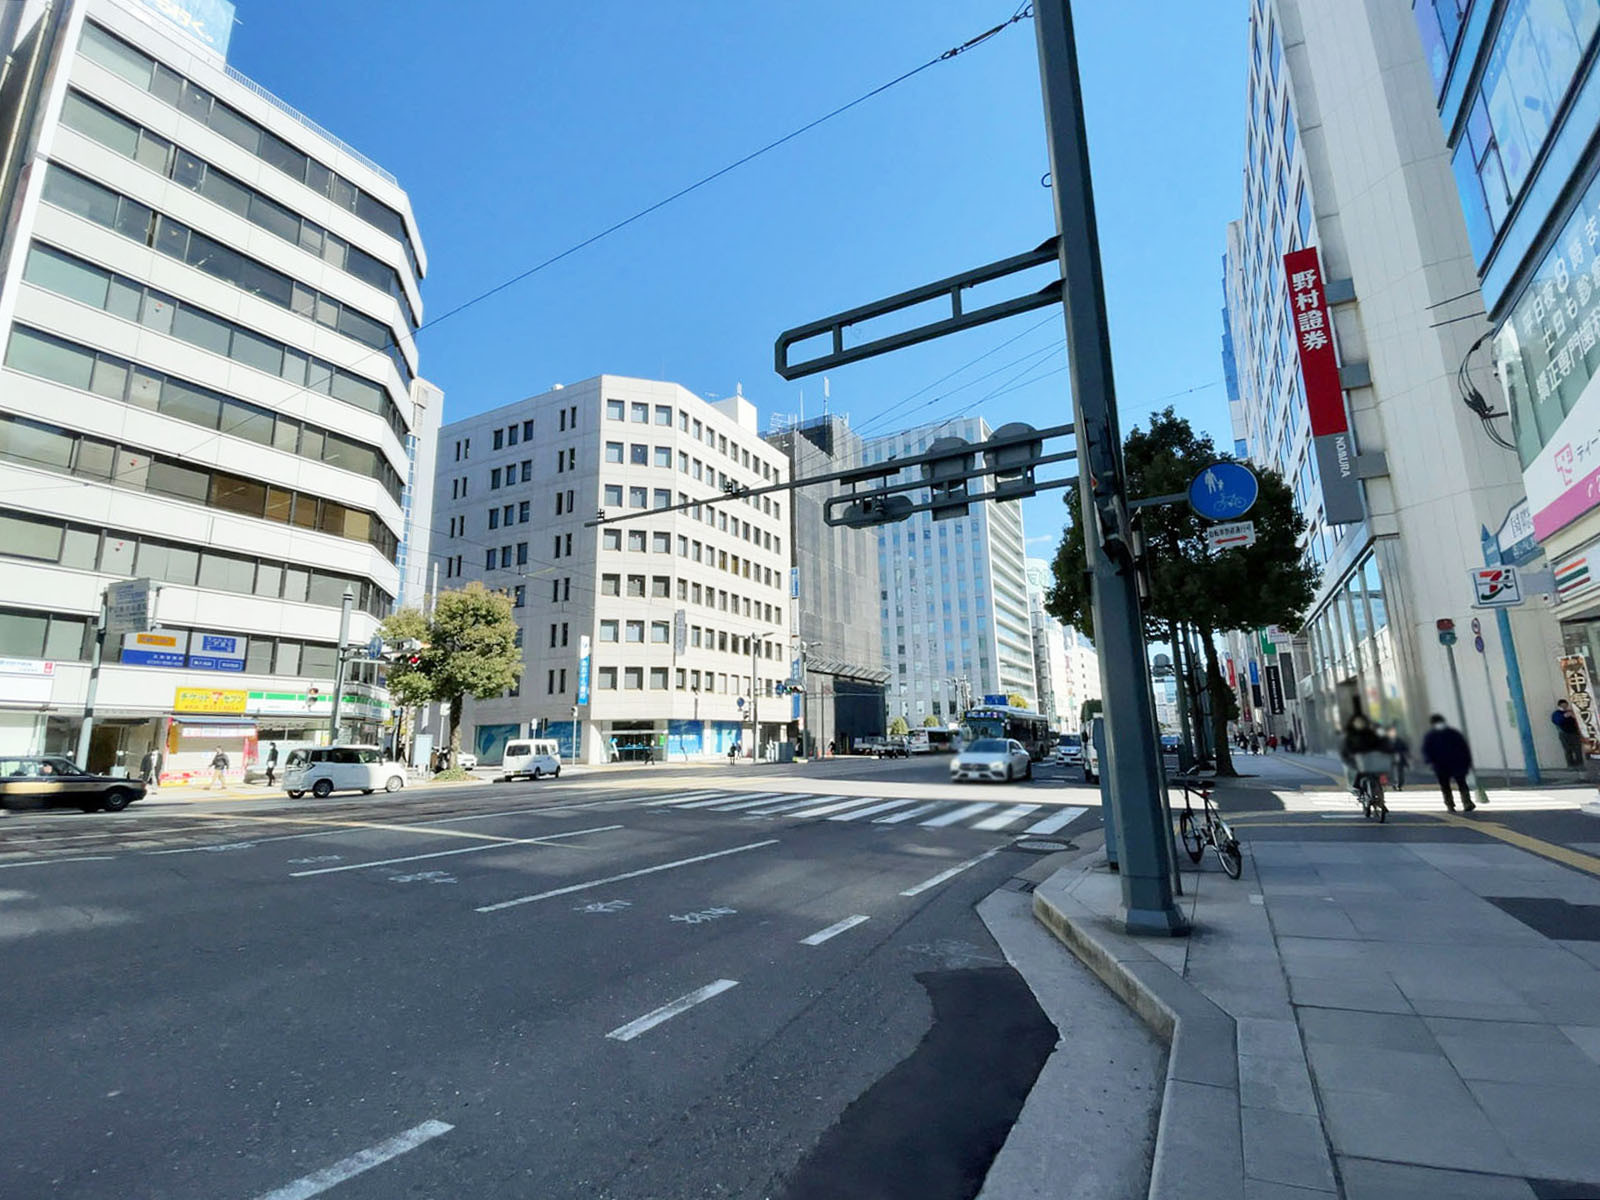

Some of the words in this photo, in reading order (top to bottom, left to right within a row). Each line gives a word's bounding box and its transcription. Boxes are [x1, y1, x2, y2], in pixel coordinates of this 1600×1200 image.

[1291, 268, 1328, 351] 野村證券
[1336, 437, 1350, 478] NOMURA
